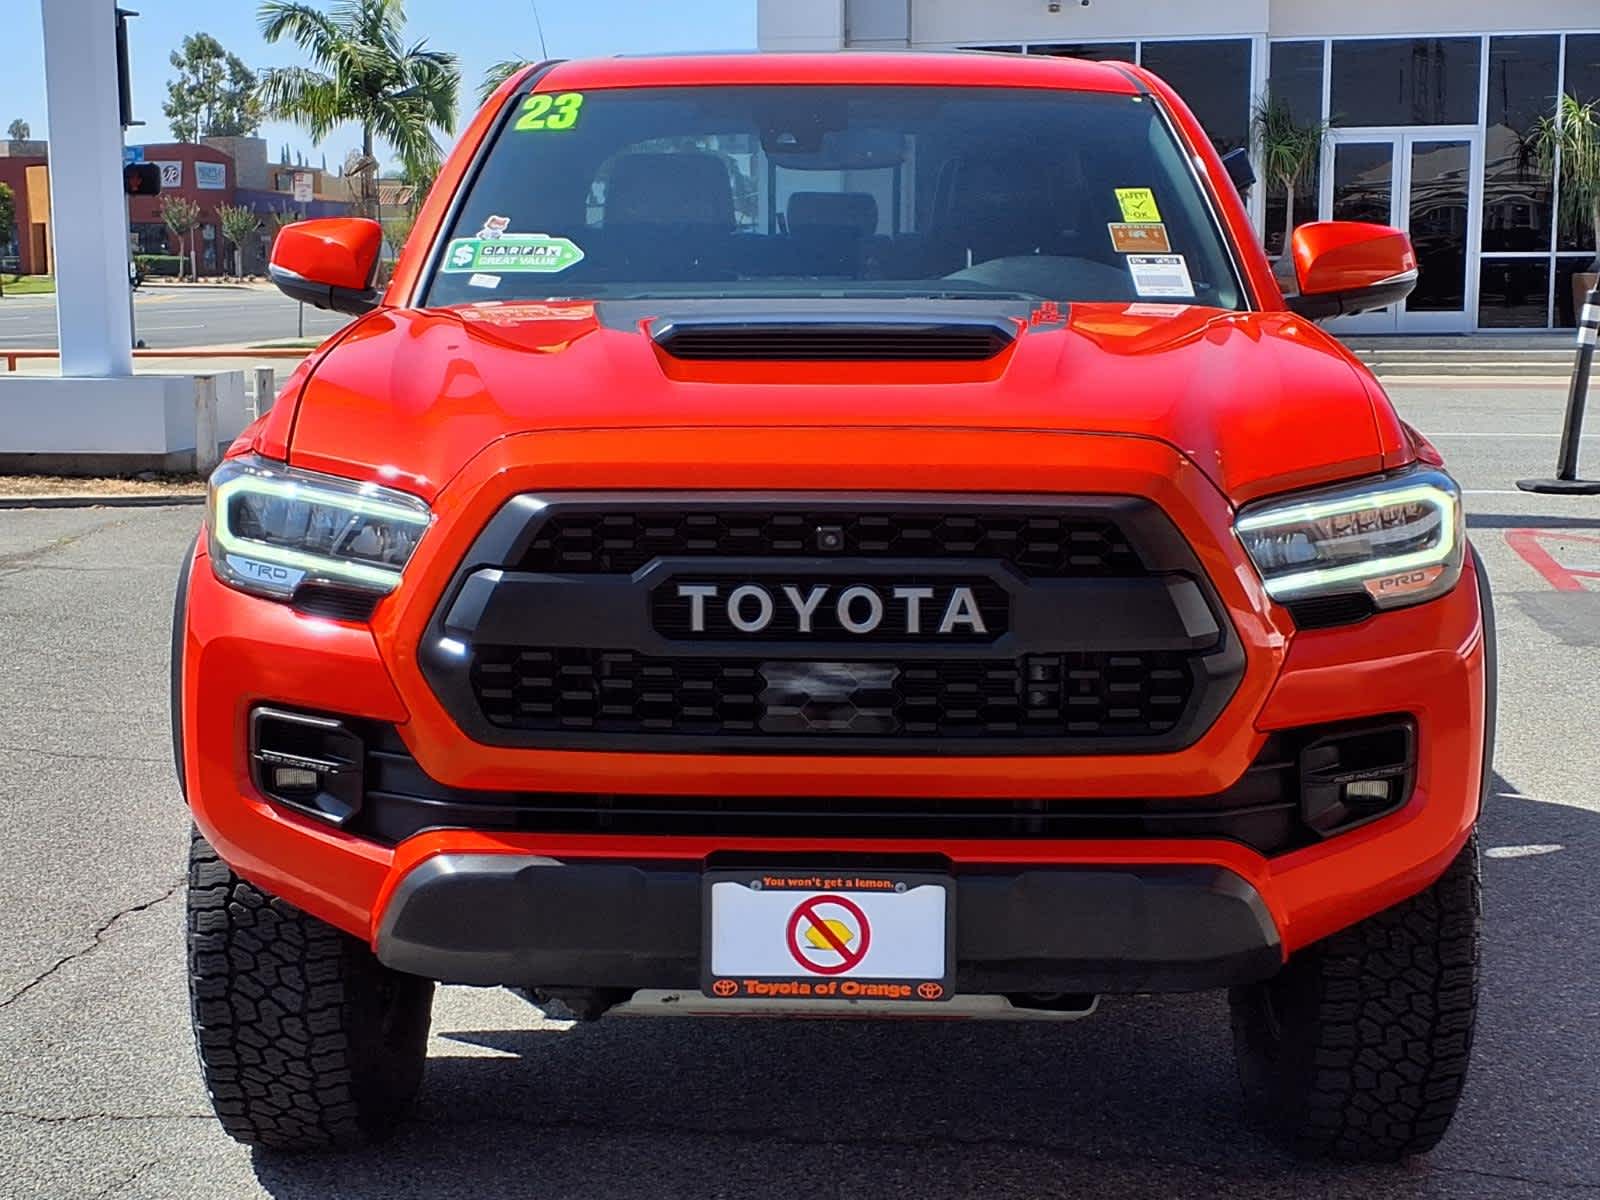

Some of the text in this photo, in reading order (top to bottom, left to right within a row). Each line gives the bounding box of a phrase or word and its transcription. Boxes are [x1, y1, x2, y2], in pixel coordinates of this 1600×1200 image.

[514, 92, 583, 130] 23
[482, 246, 560, 256] CARFAX
[479, 256, 557, 265] GREAT VALUE
[245, 561, 288, 579] TRD
[1380, 572, 1425, 590] PRO
[678, 585, 987, 633] TOYOTA
[763, 877, 784, 886] You
[788, 878, 820, 887] won't
[824, 878, 843, 888] get
[855, 878, 894, 888] lemon.
[744, 980, 912, 997] Toyota of Orange
